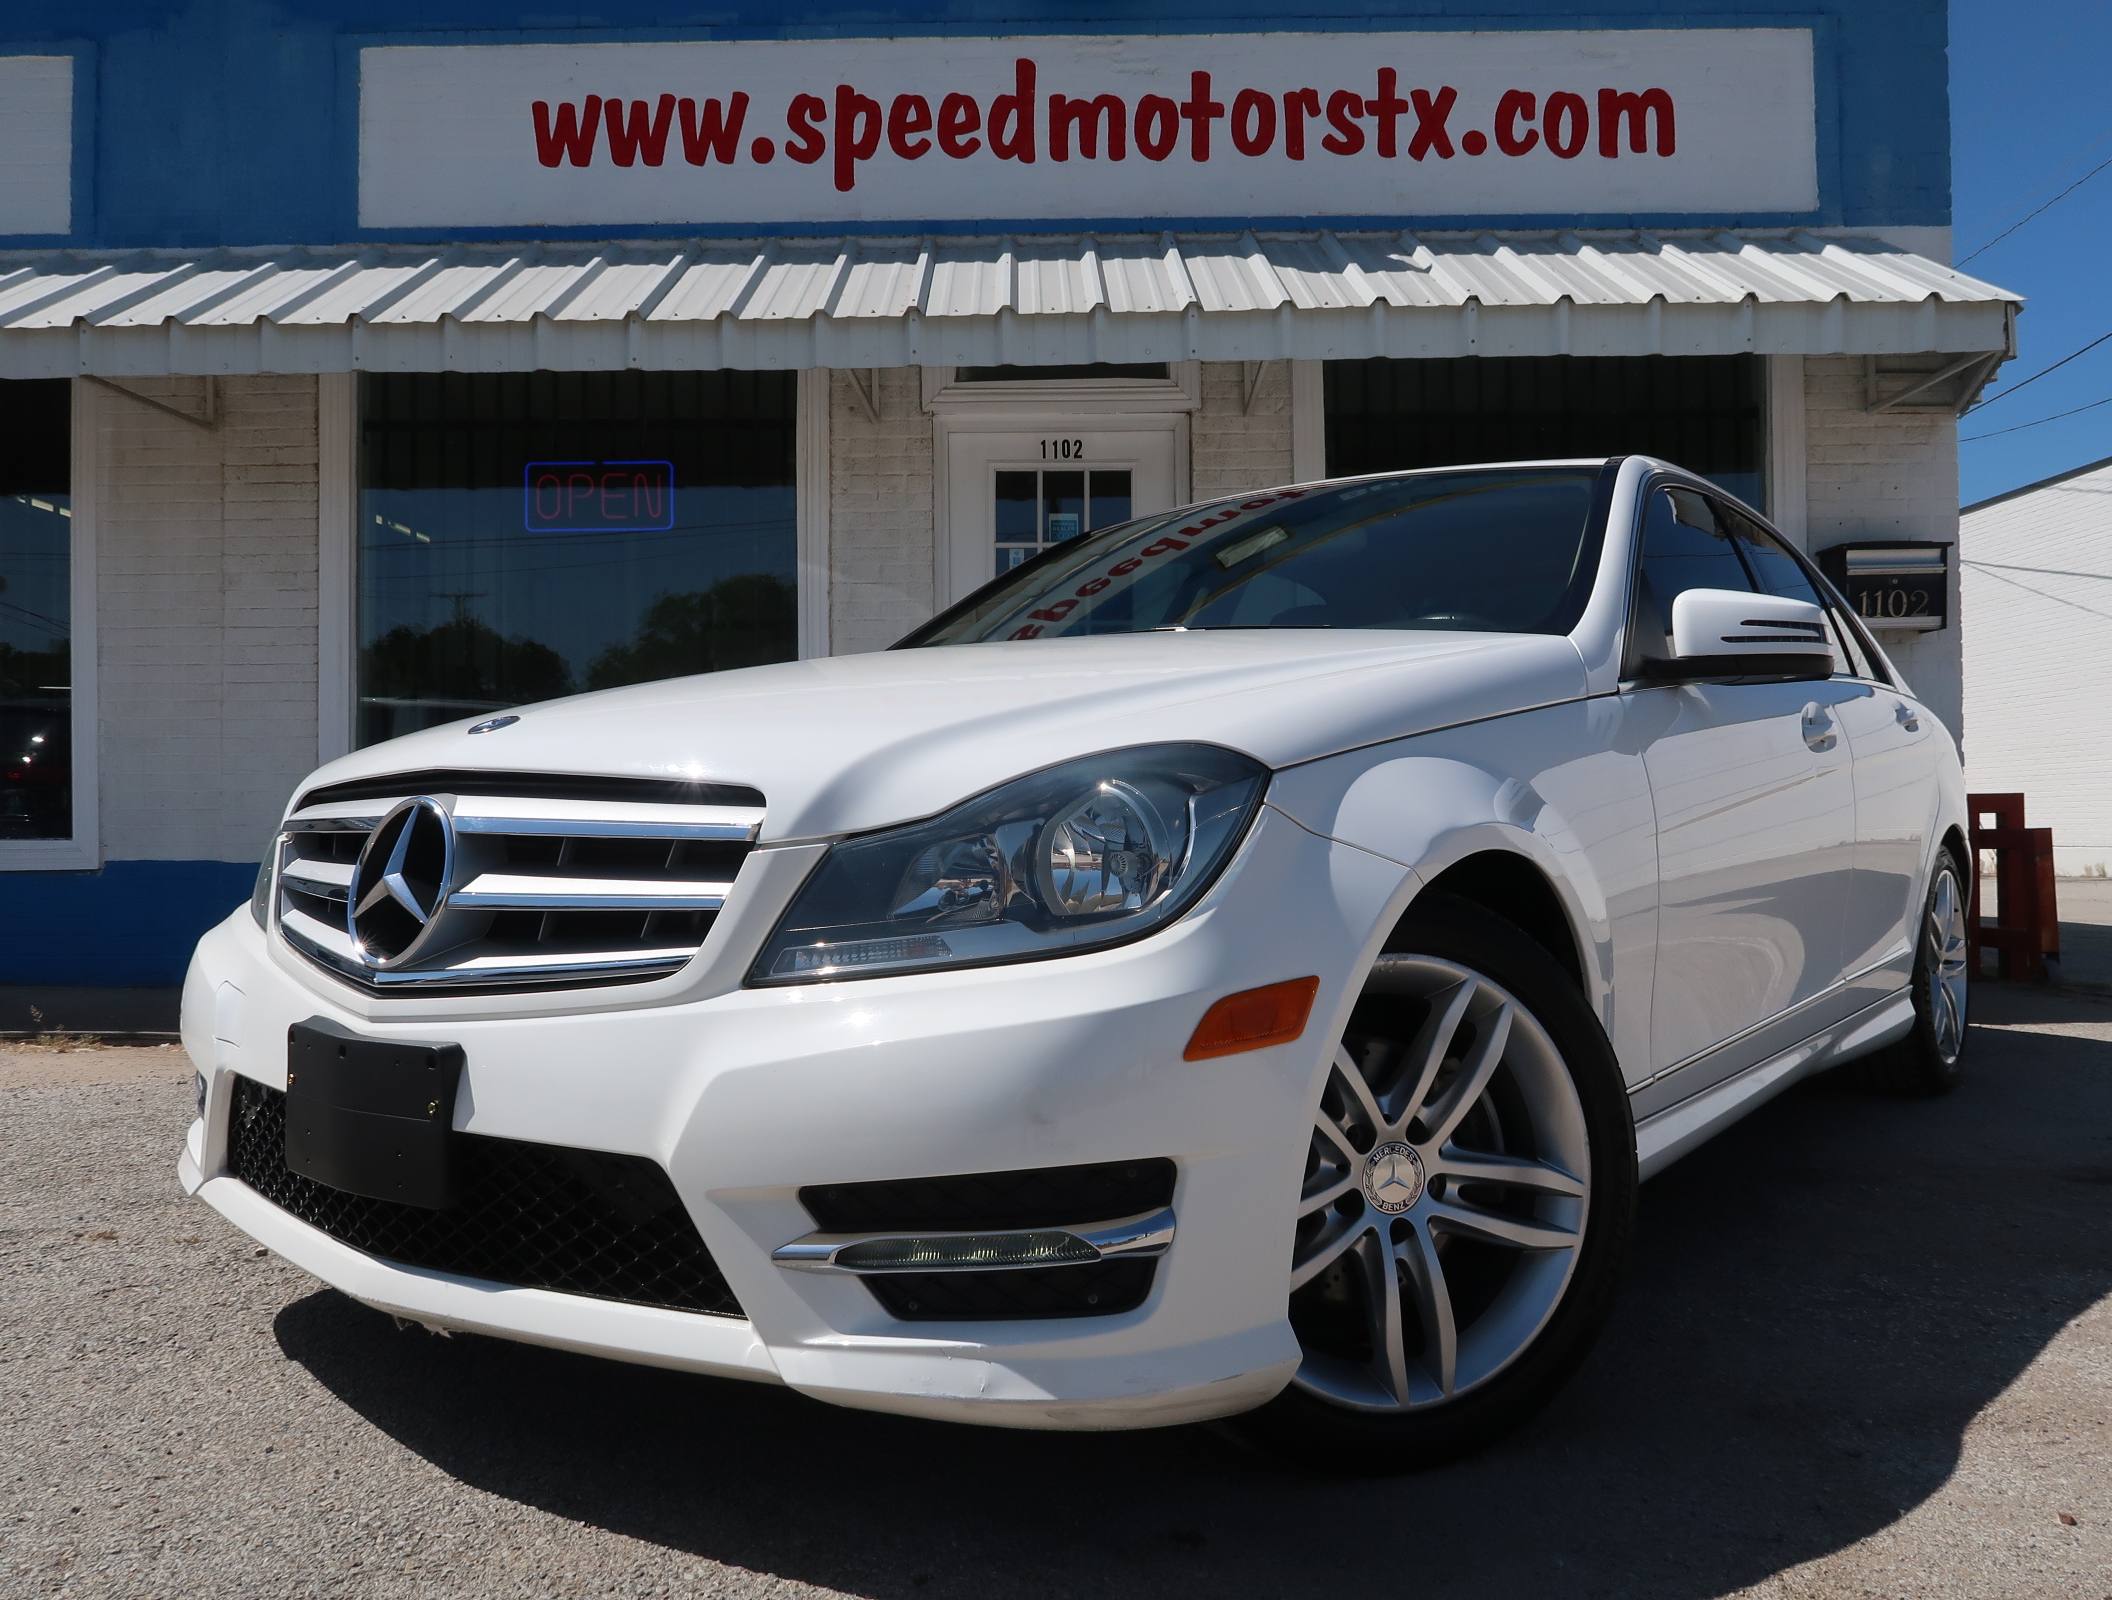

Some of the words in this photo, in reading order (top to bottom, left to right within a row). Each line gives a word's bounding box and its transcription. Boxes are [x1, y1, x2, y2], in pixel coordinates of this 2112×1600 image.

[533, 58, 1674, 190] www.speedmotorstx.com
[1040, 438, 1083, 460] 1102
[536, 473, 661, 520] OPEN
[1859, 589, 1929, 618] 1102
[1373, 1145, 1415, 1162] MERCEDES
[1382, 1201, 1405, 1211] BENZ
